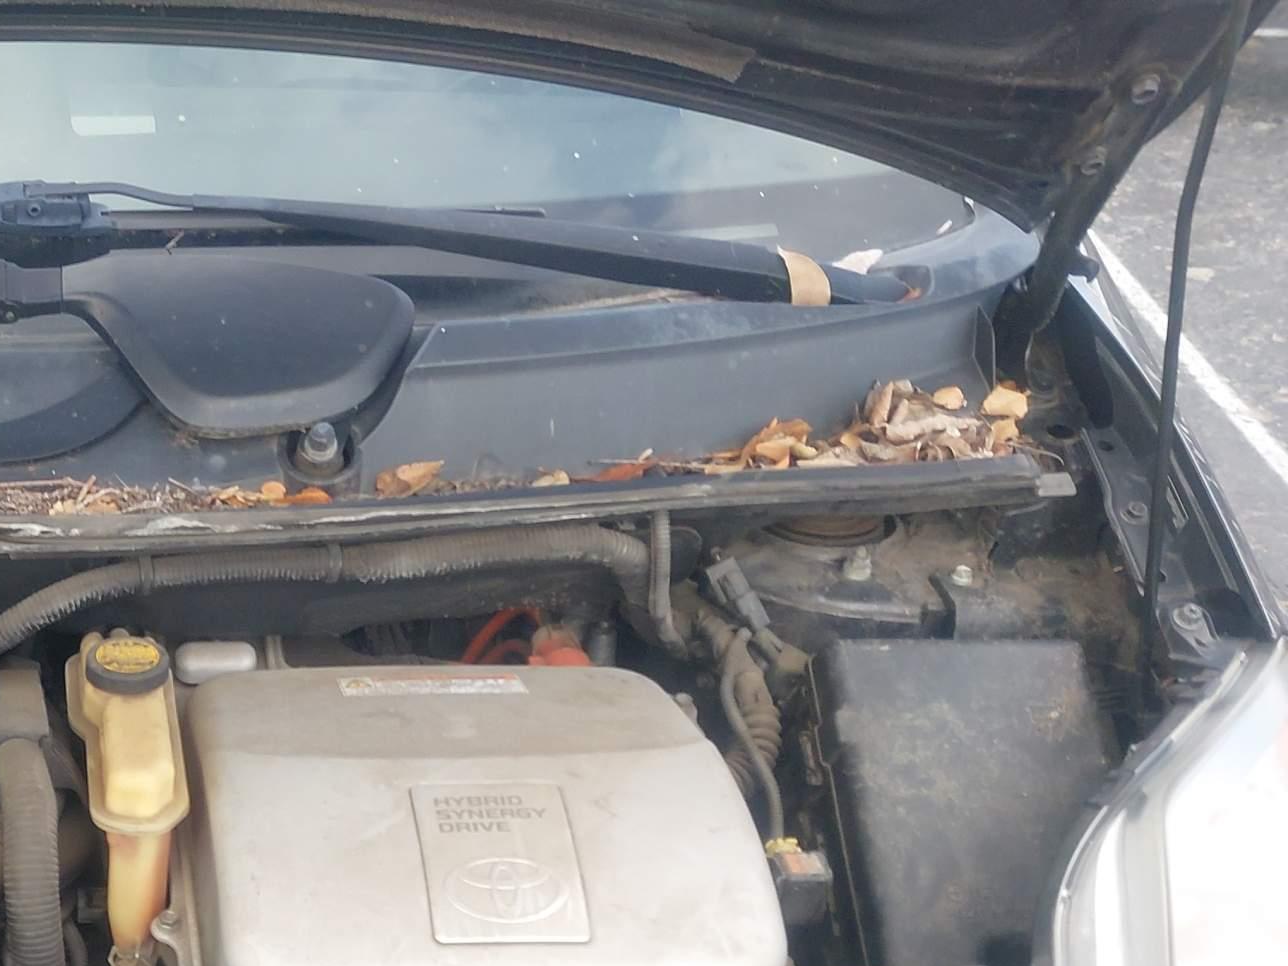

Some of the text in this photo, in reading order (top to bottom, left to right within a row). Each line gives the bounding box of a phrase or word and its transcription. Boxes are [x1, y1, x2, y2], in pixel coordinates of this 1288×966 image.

[433, 795, 523, 808] HYBRID
[435, 807, 547, 821] SYNERGY
[438, 821, 512, 834] DRIVE
